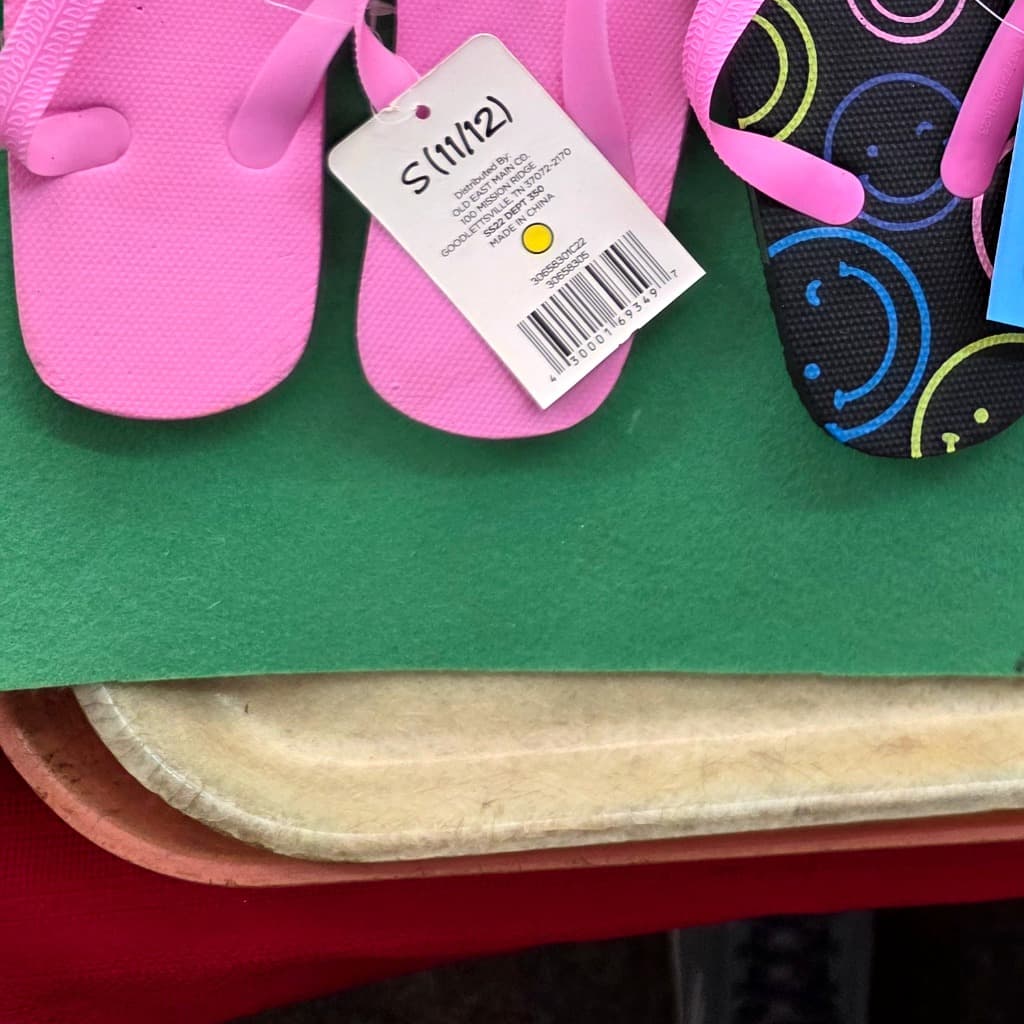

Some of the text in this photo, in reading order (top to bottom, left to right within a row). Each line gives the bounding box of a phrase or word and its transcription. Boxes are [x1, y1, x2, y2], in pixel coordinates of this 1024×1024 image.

[401, 95, 513, 195] S (11/12)
[451, 200, 471, 217] OLD
[468, 181, 492, 203] EAST
[490, 163, 516, 185] MAIN
[453, 162, 498, 200] Distributed
[459, 161, 537, 226] 100 MISSION RIDGE
[510, 185, 526, 198] TN
[523, 147, 572, 189] 37072-2170
[482, 184, 545, 238] SS22 DEPT 350
[488, 193, 556, 248] MADE IN CHINA
[530, 236, 588, 286] 30658301C22
[545, 250, 590, 289] 30658305
